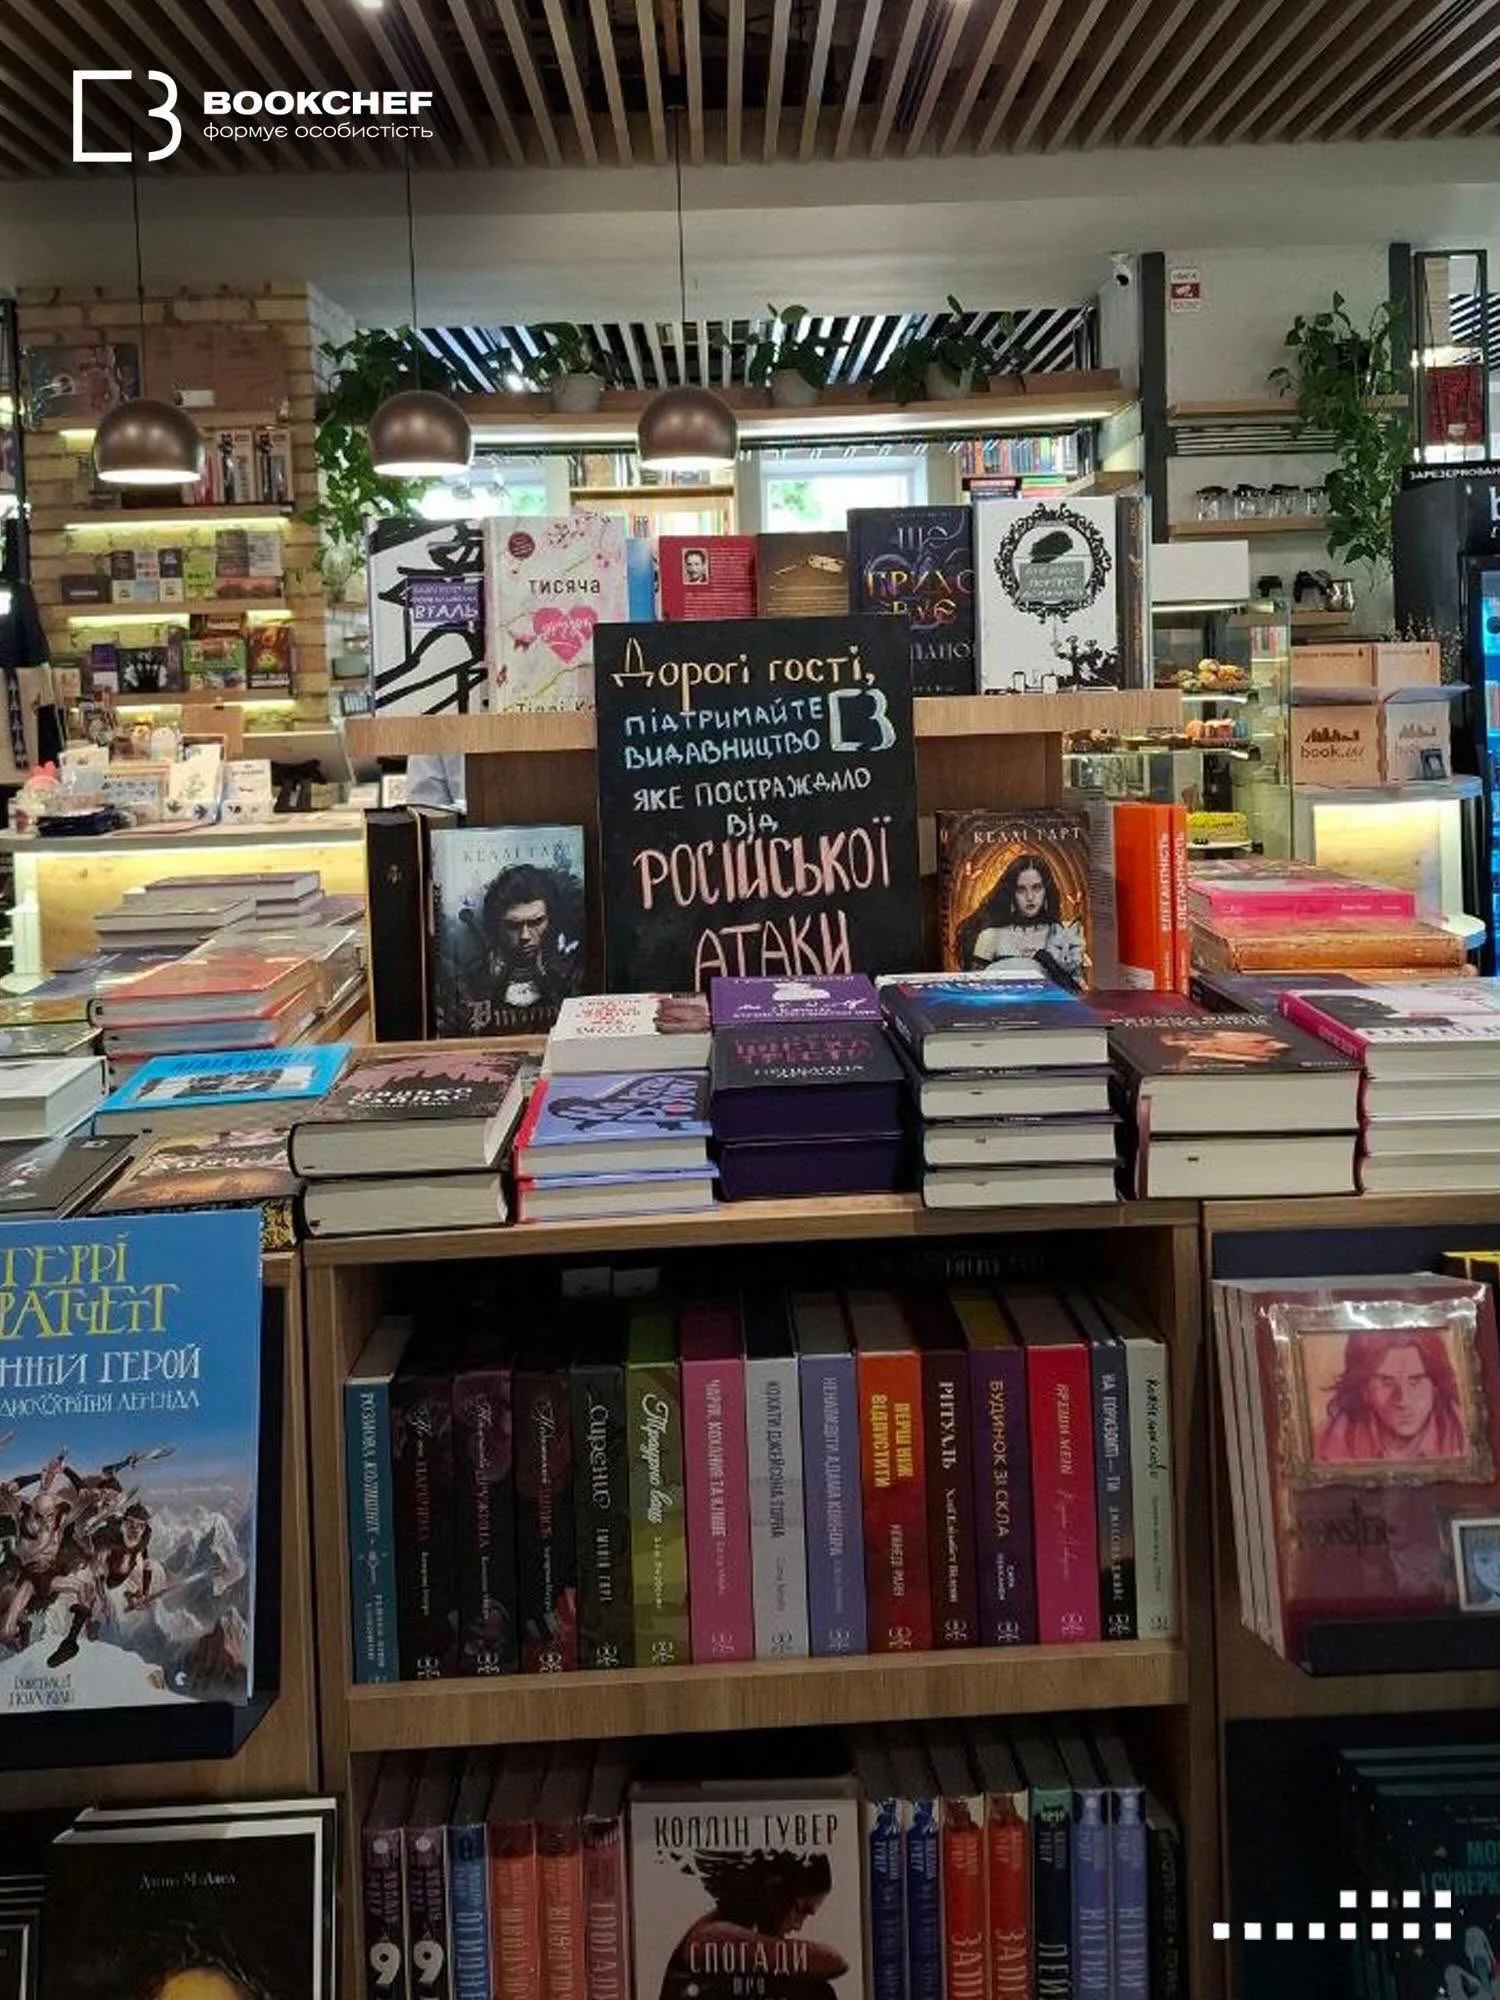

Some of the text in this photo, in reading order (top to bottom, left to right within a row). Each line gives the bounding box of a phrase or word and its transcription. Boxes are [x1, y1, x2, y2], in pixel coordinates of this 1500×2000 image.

[610, 637, 877, 715] Дорогі гості,
[626, 727, 822, 771] ВИДАВНИЦТВО
[634, 768, 872, 812] ЯКЕ ПОСТРАЖДАЛО
[634, 816, 893, 910] РОСІЙСЬКОЇ
[696, 910, 853, 988] АТАКИ
[98, 1343, 204, 1384] ГЕРОЙ
[871, 1394, 892, 1489] ВІДПУСТИТИ
[987, 1380, 1008, 1467] БУДИНОК
[993, 1488, 1011, 1538] СКЛА
[654, 1813, 839, 1849] КОЛЛІН ГУВЕР
[370, 1941, 400, 1986] 9
[412, 1939, 445, 1985] 9
[689, 1940, 809, 1978] СПОГАДИ
[1037, 1943, 1073, 2000] ЛЕЙ
